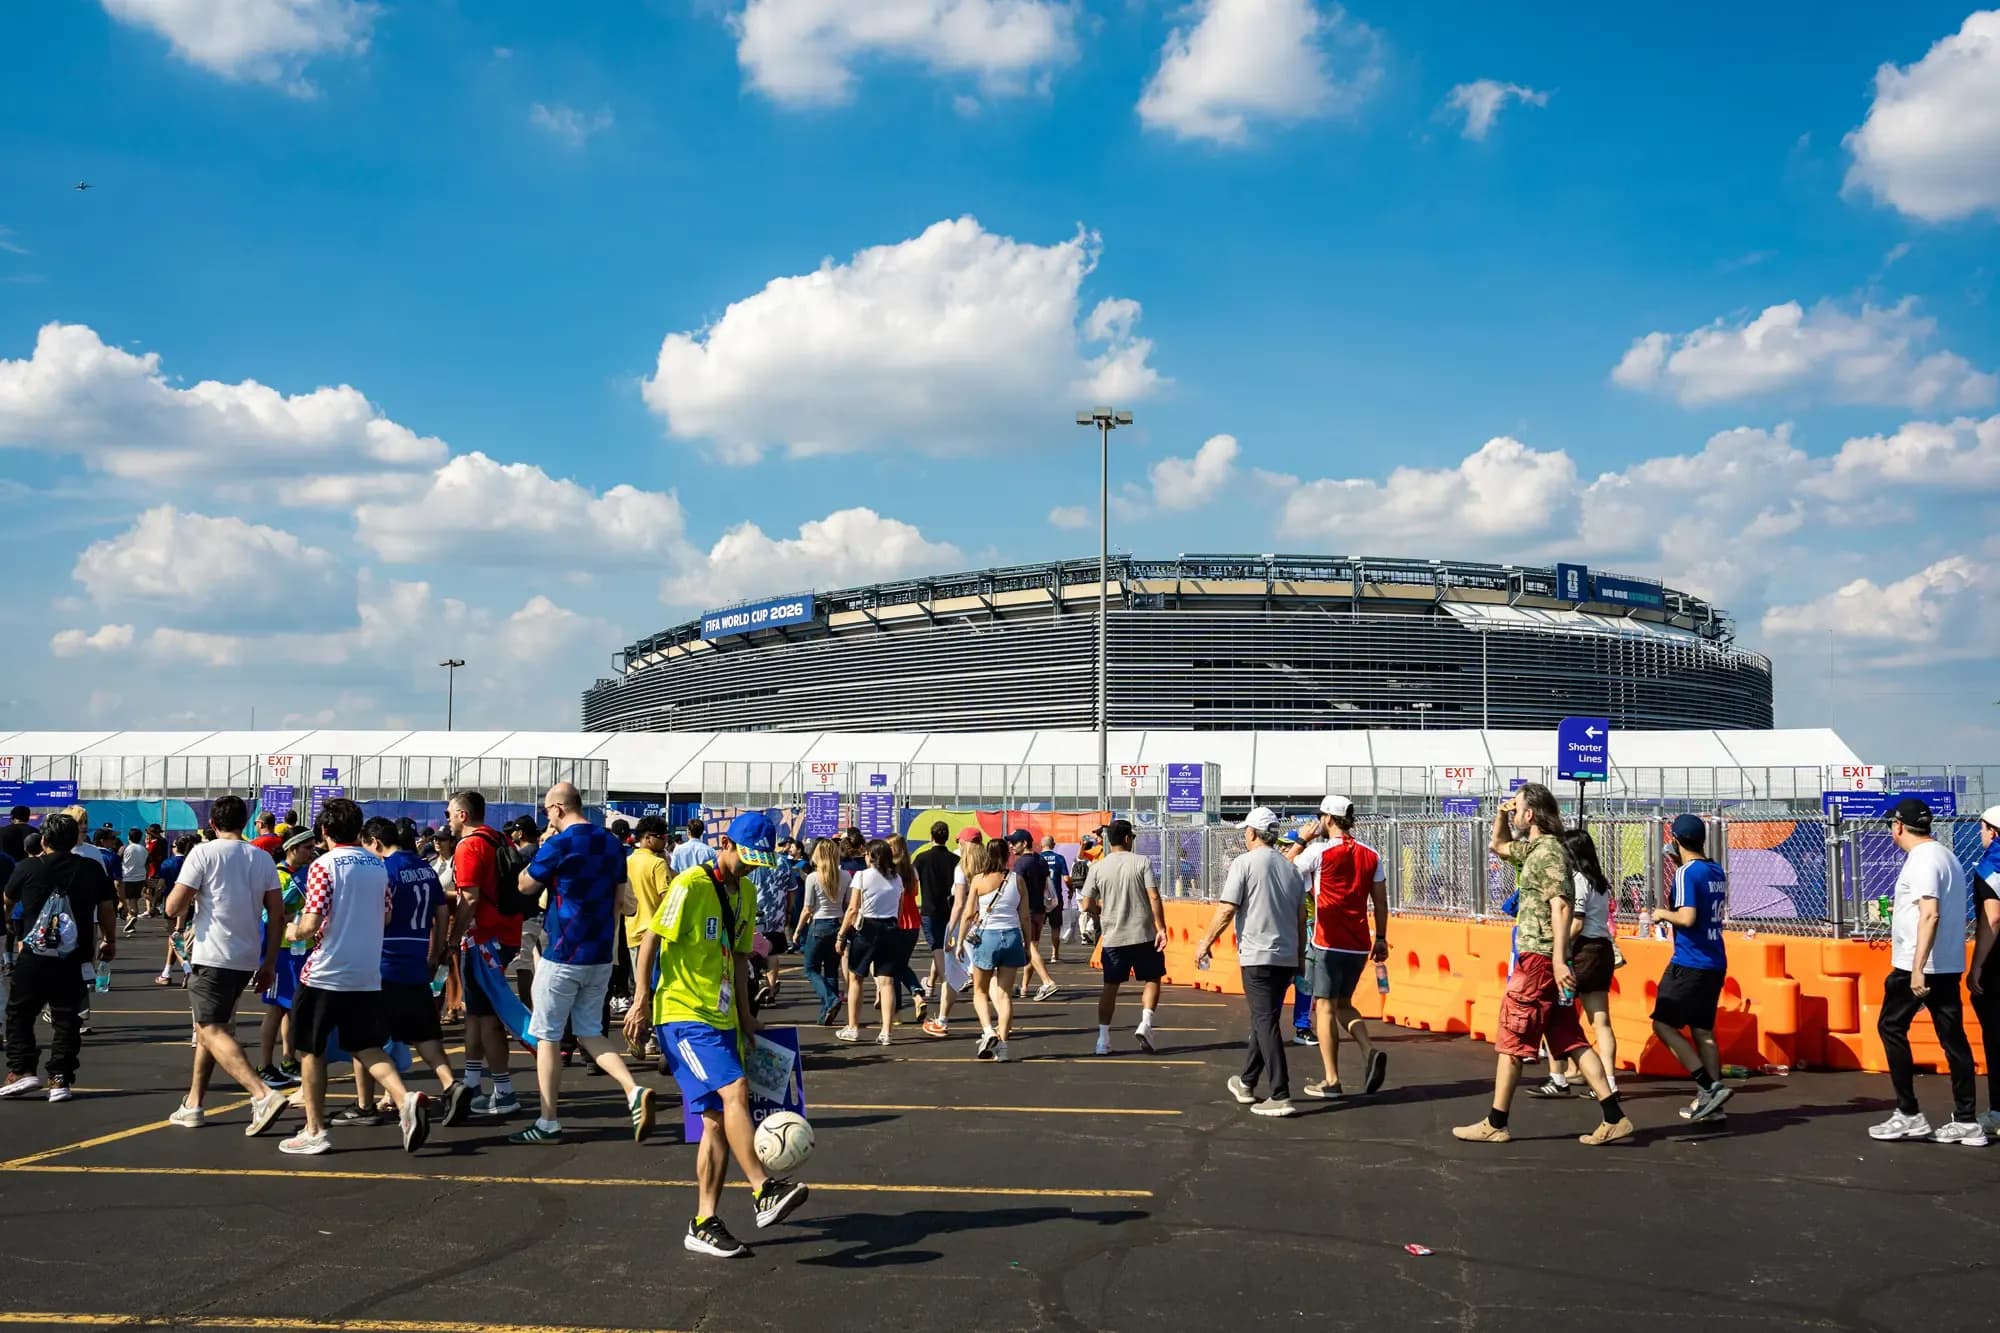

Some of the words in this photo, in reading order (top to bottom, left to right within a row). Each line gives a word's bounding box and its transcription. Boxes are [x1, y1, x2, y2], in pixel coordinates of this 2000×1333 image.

[705, 620, 720, 632] FIFA
[721, 613, 750, 629] WORLD
[751, 608, 769, 623] CUP
[770, 603, 803, 620] 2026
[1568, 742, 1602, 752] Shorter
[268, 756, 293, 766] EXIT
[1578, 754, 1602, 763] Lines
[274, 768, 286, 777] 10
[811, 763, 838, 773] EXIT
[1121, 765, 1149, 776] EXIT
[1445, 767, 1475, 778] EXIT
[1842, 766, 1873, 777] EXIT
[820, 774, 828, 784] 9
[1130, 777, 1137, 787] 8
[1856, 779, 1864, 789] 6
[1456, 780, 1463, 789] 7
[333, 855, 385, 868] BERNARD
[410, 883, 430, 930] 11
